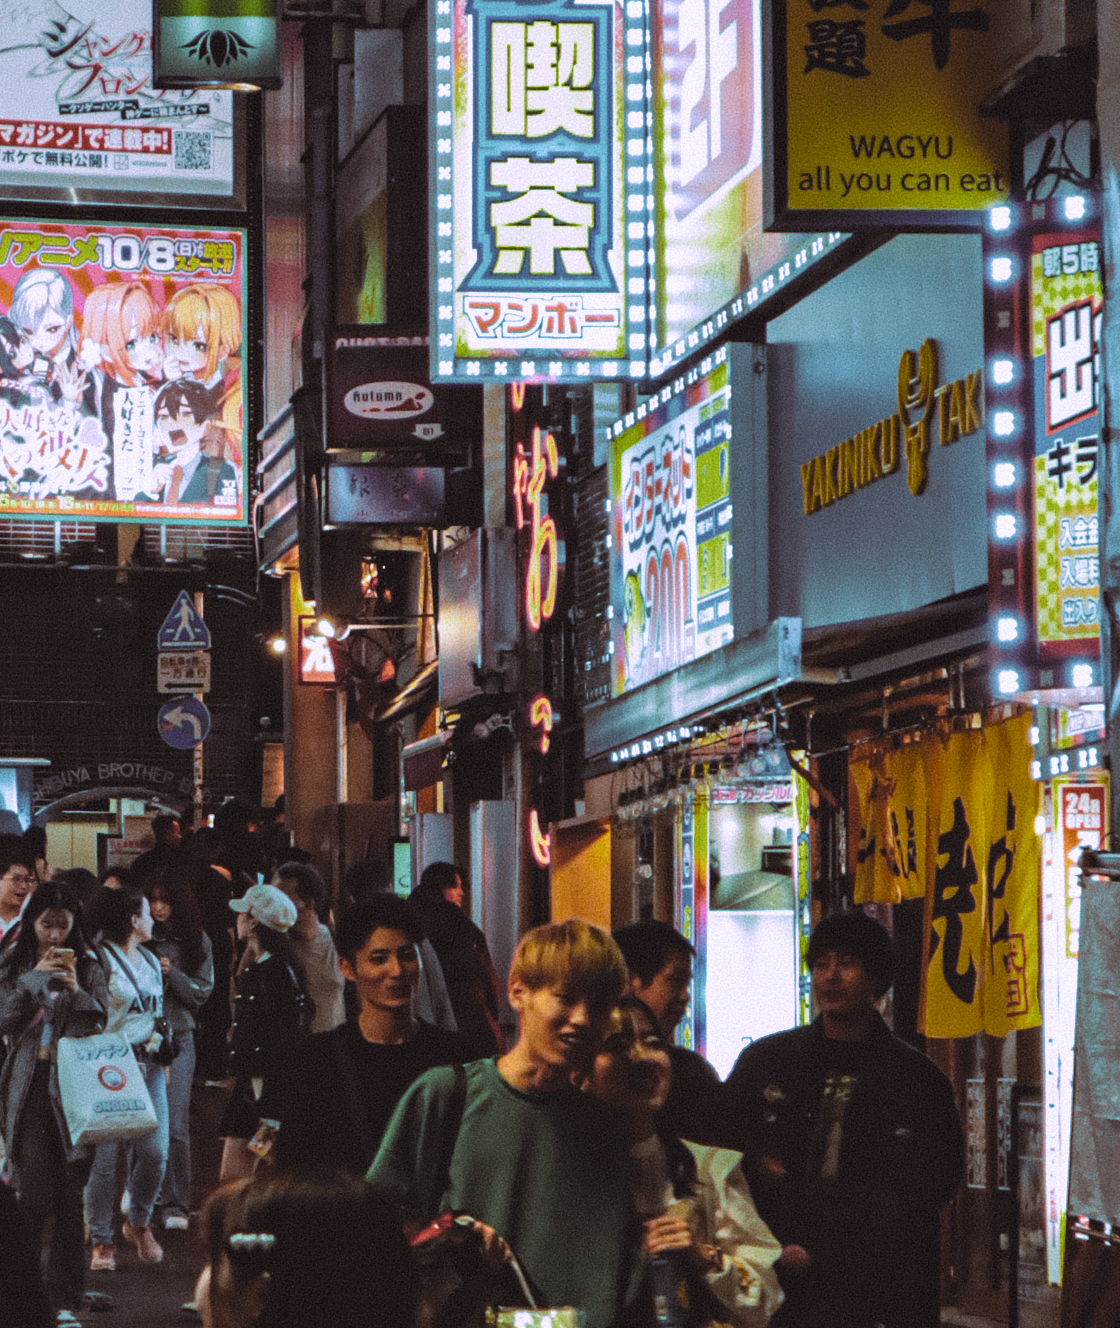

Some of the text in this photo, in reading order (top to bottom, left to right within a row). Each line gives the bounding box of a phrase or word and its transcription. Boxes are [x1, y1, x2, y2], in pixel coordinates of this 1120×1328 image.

[850, 135, 953, 159] WAGYU
[799, 166, 1005, 198] all you can eat
[466, 297, 618, 336] マンボー
[353, 390, 403, 403] Autumn
[800, 415, 901, 515] YAKINIKU
